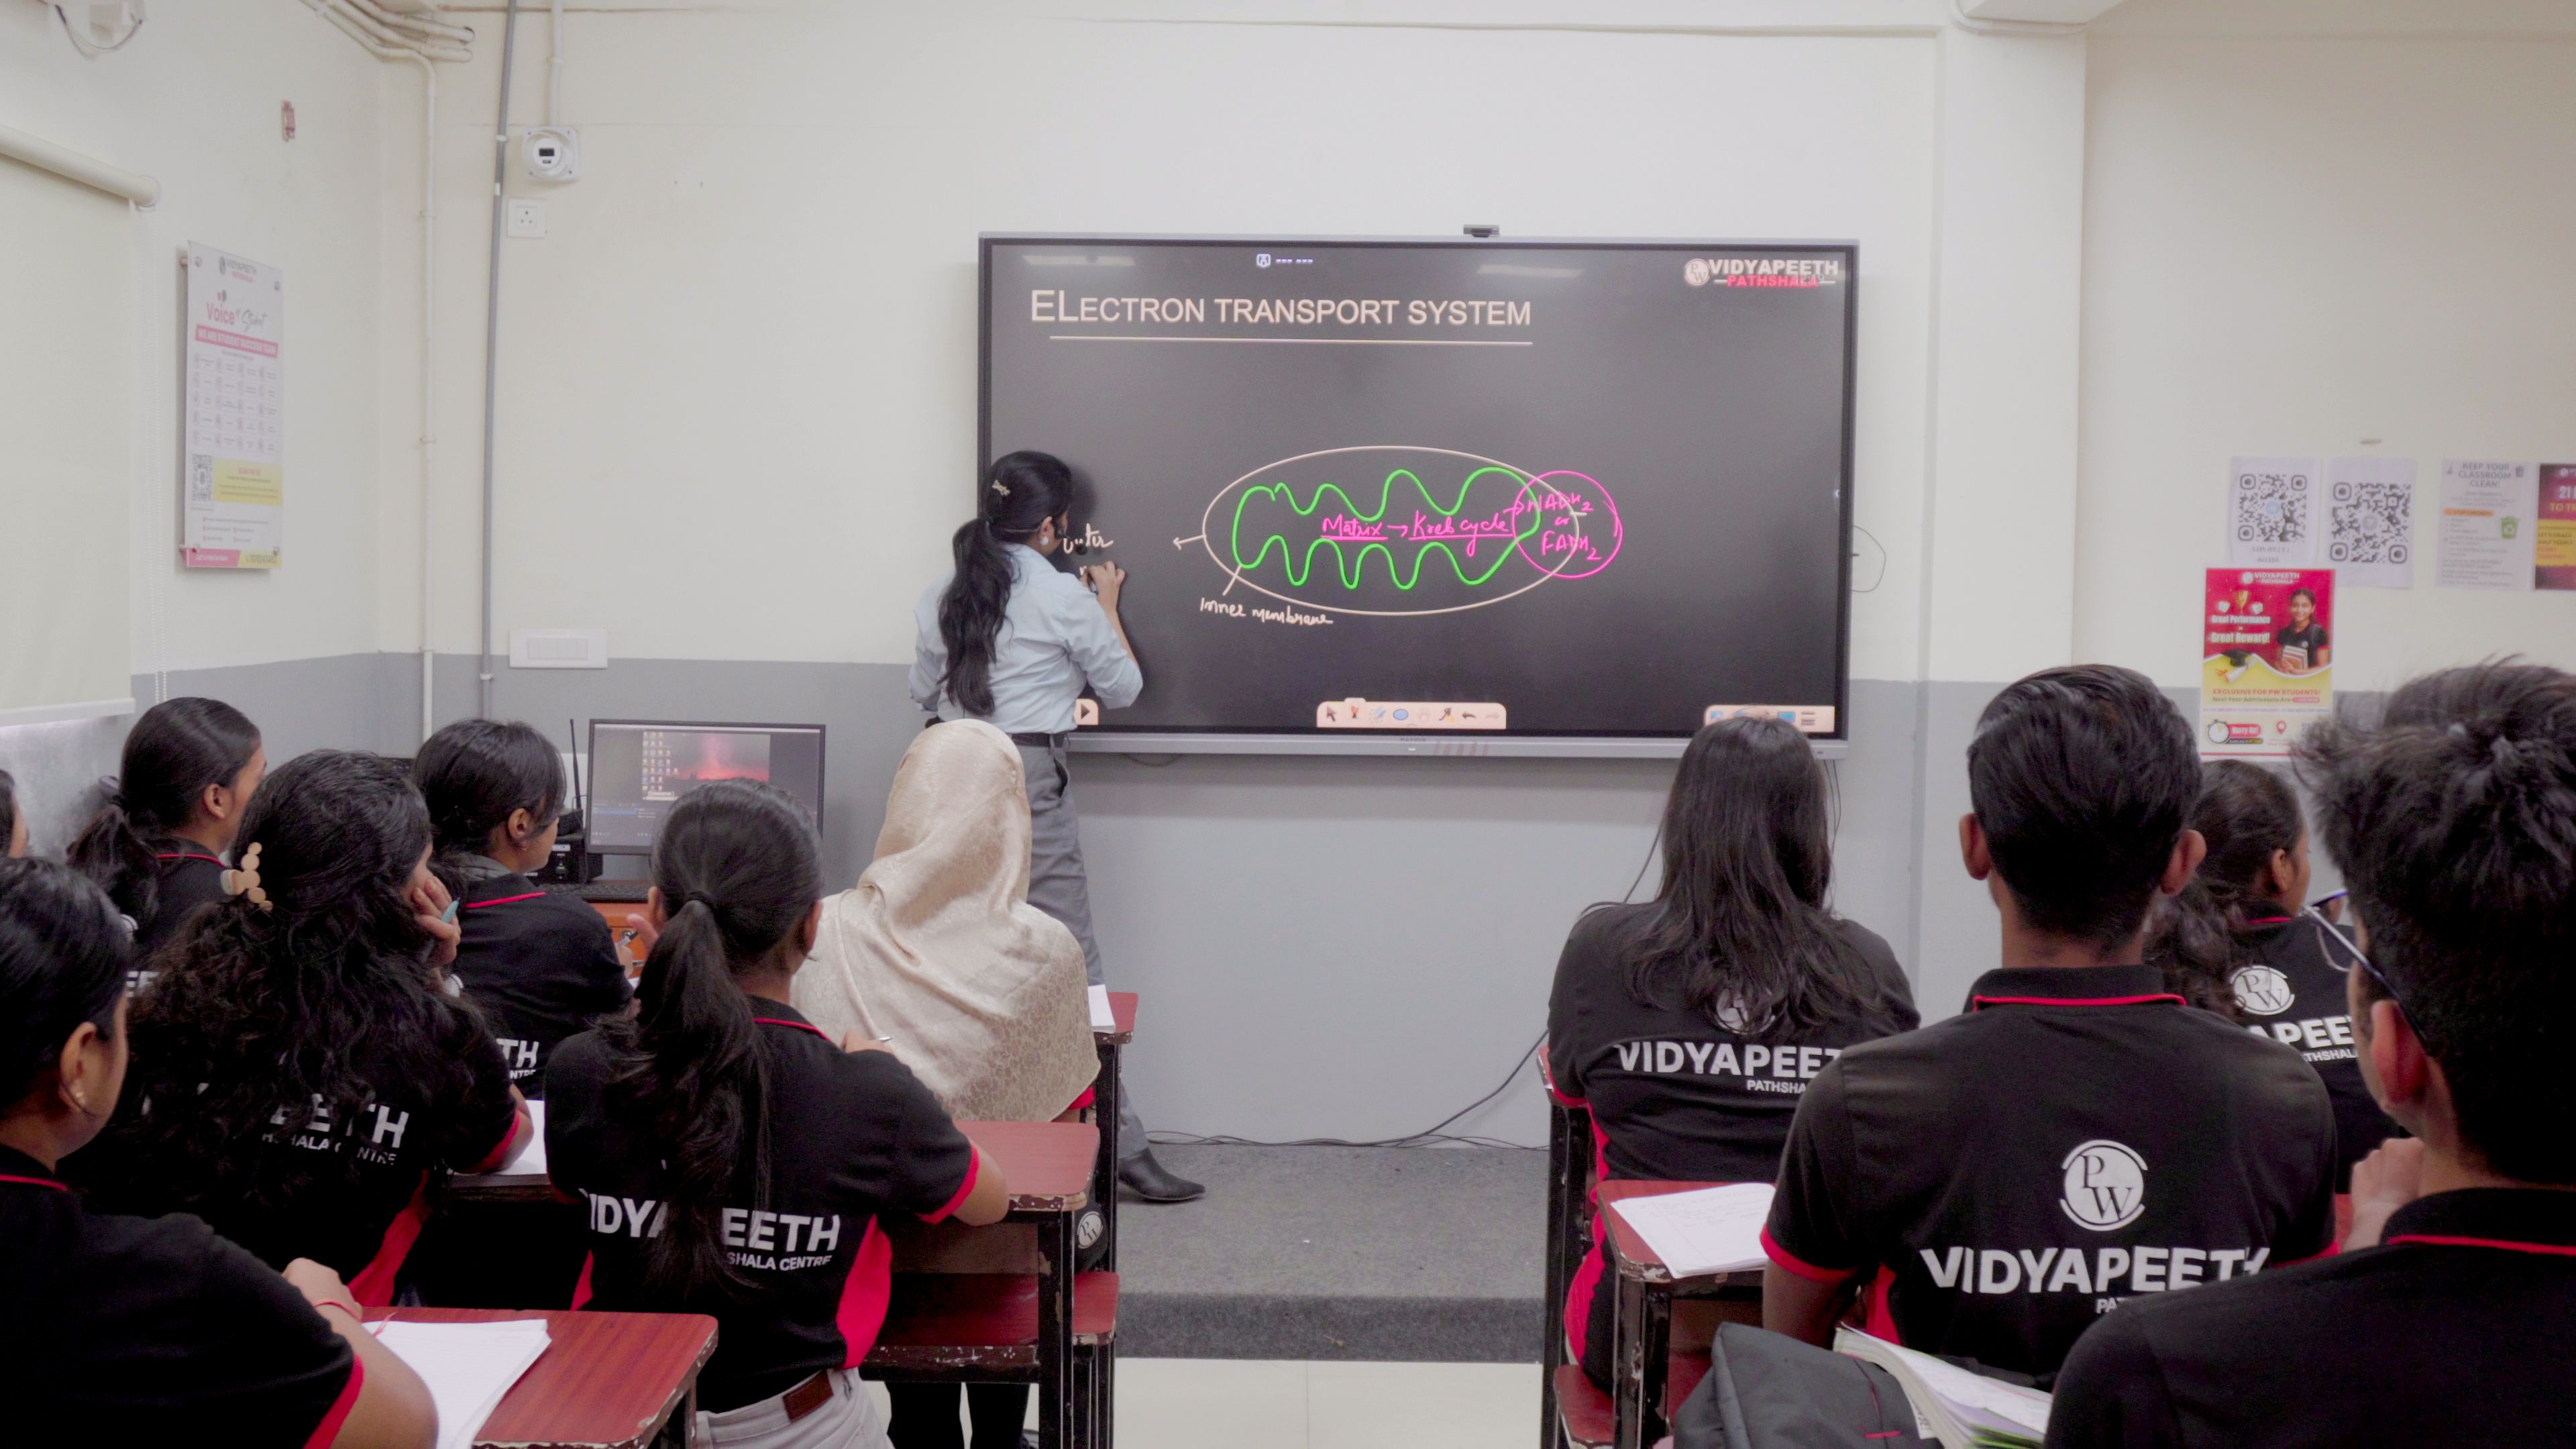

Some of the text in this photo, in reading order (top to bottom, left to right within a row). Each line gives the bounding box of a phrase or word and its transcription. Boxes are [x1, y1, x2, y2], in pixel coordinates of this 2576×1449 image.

[1709, 259, 1838, 275] VIDYAPEETH
[1726, 275, 1820, 288] PATHSHALA
[207, 302, 235, 325] Voice
[1214, 299, 1400, 325] TRANSPORT
[1407, 300, 1532, 327] SYSTEM
[2459, 471, 2511, 479] CLASSROOM
[1322, 513, 1383, 537] Matrix
[1459, 513, 1509, 557] cycle
[1252, 605, 1334, 625] membrane
[2210, 615, 2271, 624] Great Performance
[2210, 632, 2234, 643] Great
[1613, 1040, 1843, 1079] VIDYAPEE
[1746, 1079, 1807, 1094] PATHSHA
[727, 1252, 777, 1271] SHALA
[1919, 1245, 2271, 1295] VIDYAPEETH
